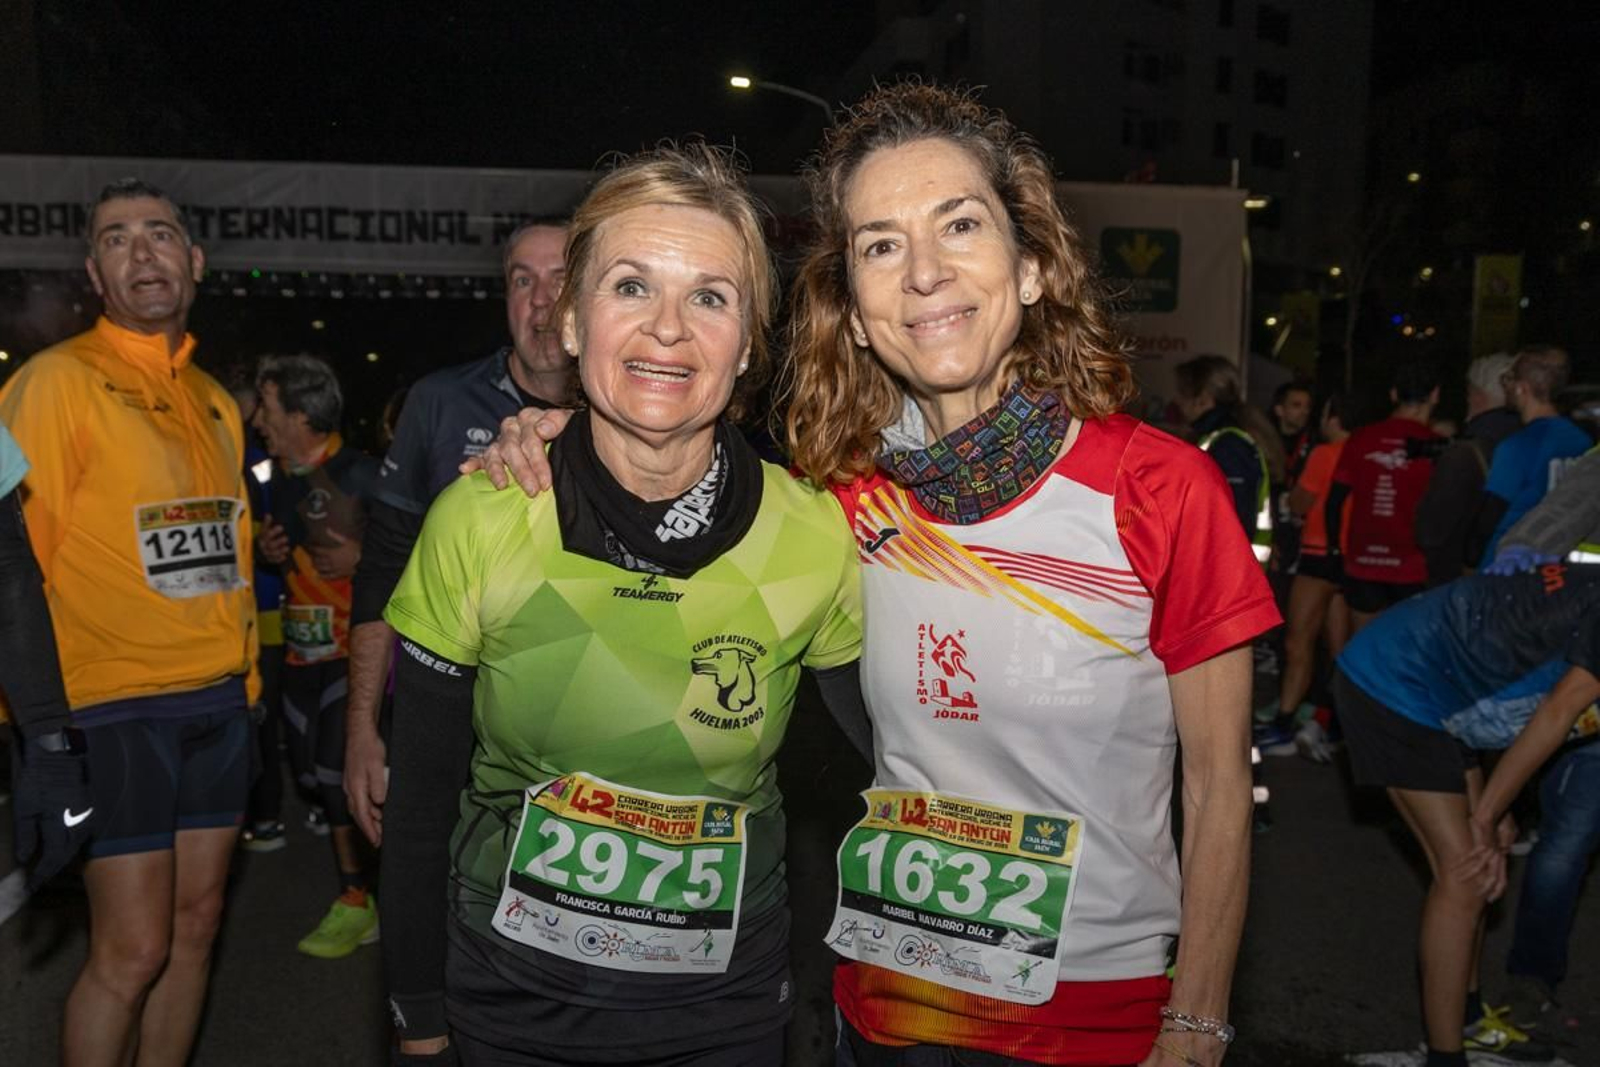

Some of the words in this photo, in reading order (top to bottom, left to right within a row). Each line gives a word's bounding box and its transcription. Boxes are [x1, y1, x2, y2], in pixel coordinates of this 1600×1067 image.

[181, 204, 481, 246] TERNACIONAL
[145, 525, 233, 559] 12118
[612, 587, 685, 603] TEAMERGY
[401, 640, 463, 677] URBEL
[692, 637, 714, 653] CLUB
[714, 635, 725, 644] DE
[727, 635, 768, 656] ATLETISMO
[917, 623, 928, 705] ATLETISMO
[689, 707, 741, 730] HUELMA
[742, 706, 765, 727] 2003
[569, 785, 615, 818] 42
[617, 795, 665, 811] CARRERA
[901, 798, 929, 828] 42
[974, 806, 1013, 821] URBANA
[614, 810, 647, 827] SAN
[928, 814, 958, 832] SAN
[524, 817, 724, 909] 2975
[855, 832, 1049, 931] 1632
[555, 892, 611, 914] FRANCISCA
[614, 906, 653, 921] GARCÍA
[655, 913, 687, 925] RUBIO
[882, 904, 917, 921] MARIBEL
[918, 911, 964, 933] NAVARRO
[967, 923, 995, 939] DÍAZ
